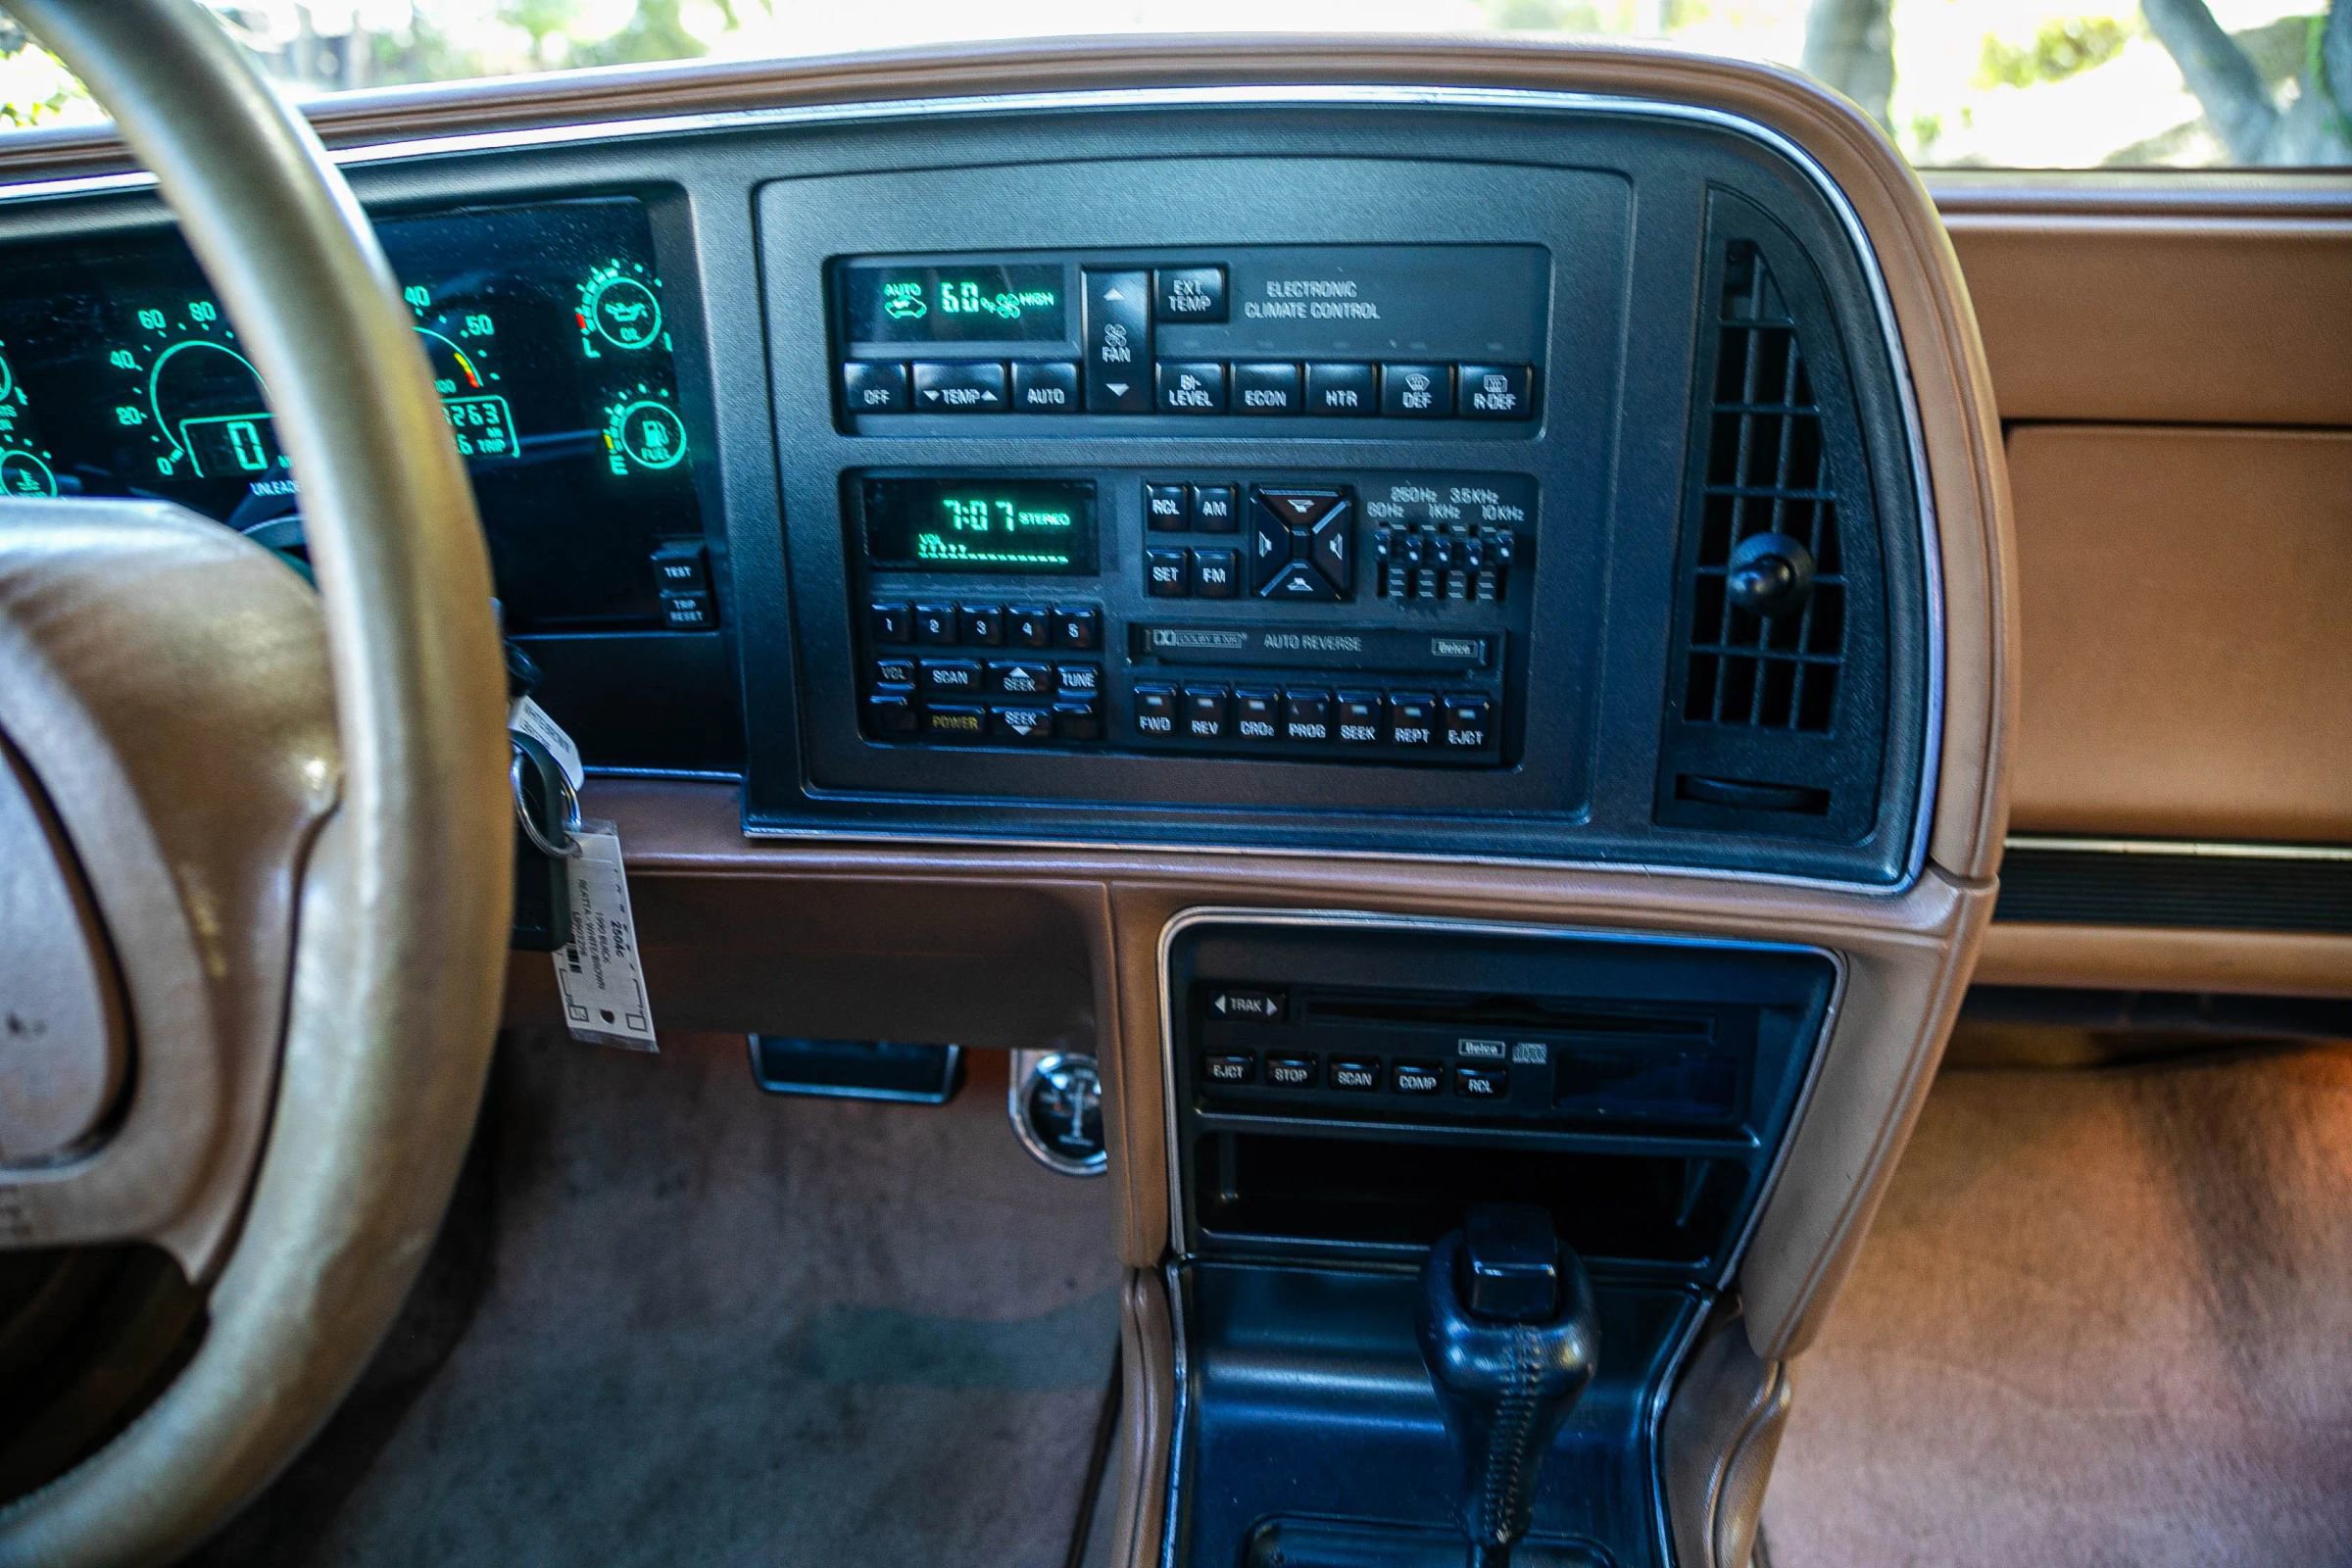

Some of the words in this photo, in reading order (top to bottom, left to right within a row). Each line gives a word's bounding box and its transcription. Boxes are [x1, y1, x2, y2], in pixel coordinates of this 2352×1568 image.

[884, 283, 921, 297] AUTO
[1173, 279, 1201, 295] EXT
[1266, 280, 1357, 298] ELECTRONIC
[1167, 296, 1212, 312] TEMP
[1245, 302, 1308, 318] CLIMATE
[1310, 302, 1381, 319] CONTROL
[138, 309, 166, 329] 60
[466, 314, 494, 335] 50
[110, 350, 136, 369] 40
[1102, 347, 1131, 363] FAN
[863, 390, 890, 405] OFF
[941, 389, 981, 405] TEMP
[1027, 389, 1065, 405] AUTO
[1168, 390, 1213, 407] LEVEL
[1245, 390, 1286, 407] ECON
[1326, 390, 1358, 407] HTR
[1402, 391, 1433, 409] DEF
[116, 406, 142, 425] 20
[227, 421, 269, 470] 0
[157, 457, 173, 476] 0
[610, 455, 628, 474] E
[1152, 499, 1180, 515] RCL
[1202, 501, 1227, 517] AM
[944, 500, 1015, 531] 7:07
[1018, 512, 1071, 525] STEREO
[664, 565, 691, 577] TEST
[1152, 565, 1179, 582] SET
[1202, 566, 1226, 584] FM
[885, 618, 893, 632] 1
[929, 619, 940, 633] 2
[976, 620, 987, 635] 3
[1022, 622, 1033, 636] 4
[1068, 623, 1079, 637] 5
[1264, 633, 1299, 649] AUTO
[1302, 635, 1362, 652] REVERSE
[932, 669, 968, 685] SCAN
[1003, 677, 1035, 692] SEEK
[1061, 672, 1096, 688] TUNE
[932, 714, 978, 730] POWER
[1004, 710, 1037, 726] SEEK
[1140, 716, 1171, 732] FWD
[1192, 719, 1218, 735] REV
[1289, 723, 1326, 739] PROG
[1341, 725, 1376, 741] SEEK
[1395, 728, 1431, 744] REPT
[1448, 730, 1485, 746] EJCT
[1230, 998, 1261, 1013] TRAK
[1275, 1067, 1307, 1083] STOP
[1338, 1071, 1372, 1087] SCAN
[1398, 1075, 1438, 1091] COMP
